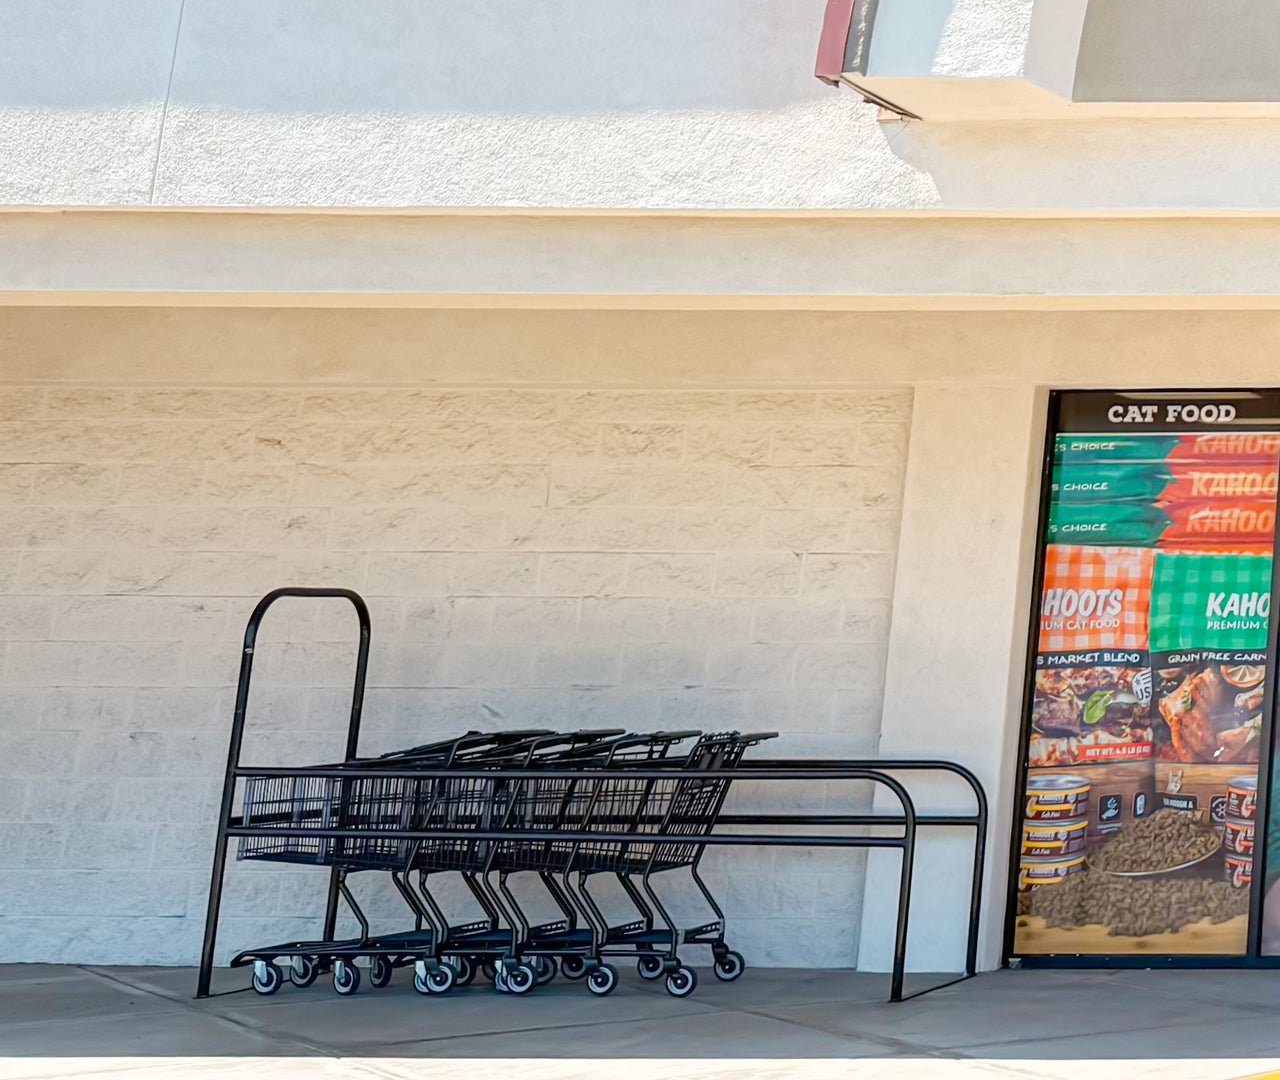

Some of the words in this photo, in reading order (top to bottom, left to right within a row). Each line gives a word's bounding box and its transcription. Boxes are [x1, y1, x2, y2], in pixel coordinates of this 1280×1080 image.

[1107, 404, 1158, 423] CAT
[1166, 404, 1237, 423] FOOD
[1071, 442, 1116, 451] CHOICE
[1063, 482, 1108, 491] CHOICE
[1062, 523, 1107, 532] CHOICE
[1042, 588, 1124, 618] HOOTS
[1067, 620, 1087, 630] CAT
[1090, 619, 1120, 629] FOOD
[1207, 620, 1260, 630] PREMIUM
[1048, 653, 1100, 664] MARKET
[1103, 652, 1141, 663] BLEND
[1168, 653, 1200, 664] GRAIN
[1202, 652, 1231, 662] FREE
[1086, 748, 1100, 756] NET
